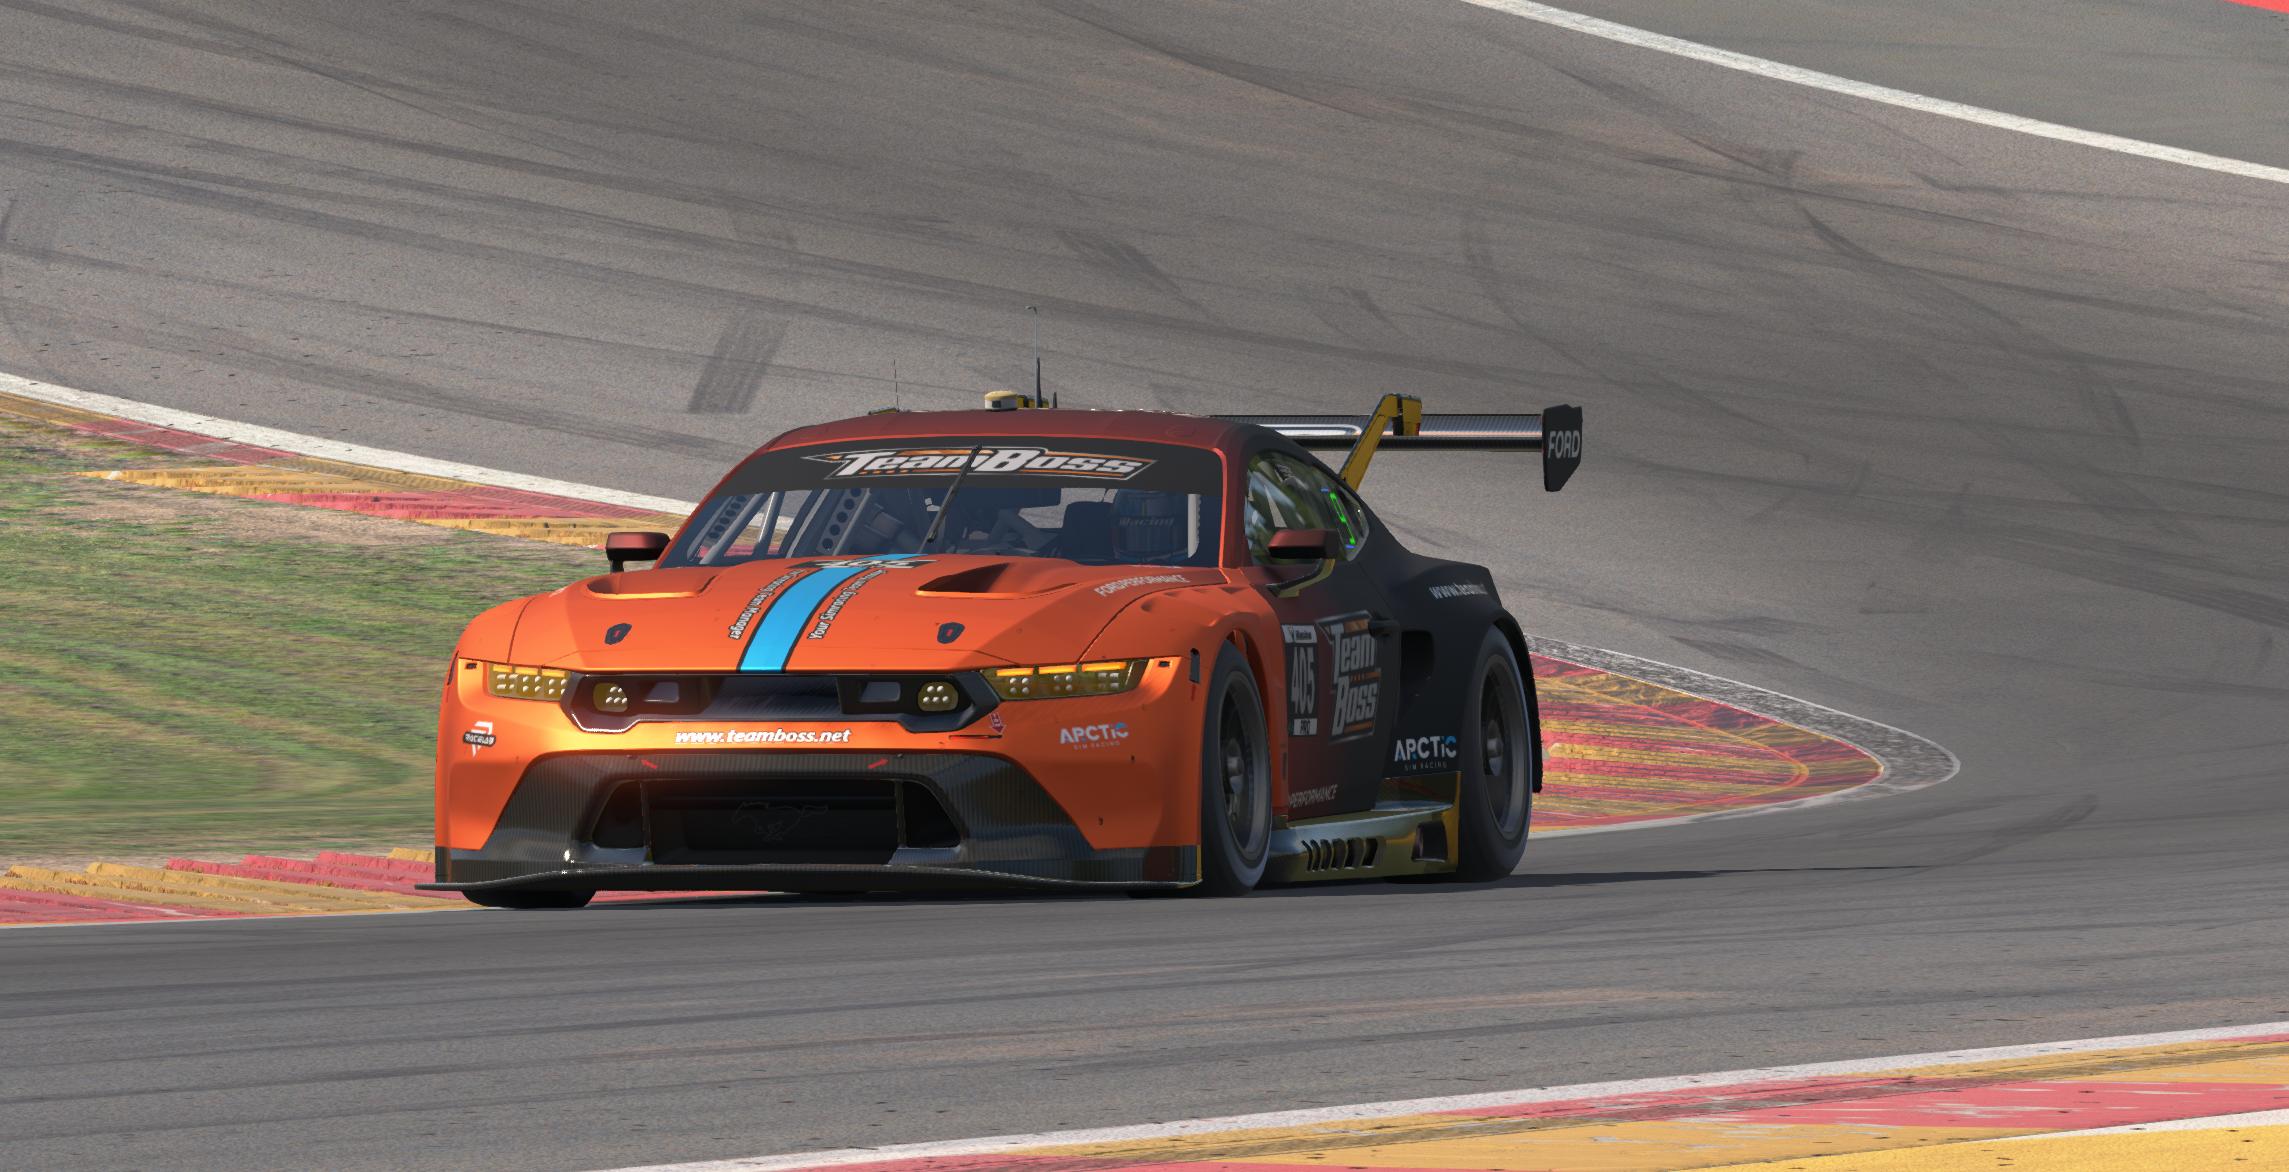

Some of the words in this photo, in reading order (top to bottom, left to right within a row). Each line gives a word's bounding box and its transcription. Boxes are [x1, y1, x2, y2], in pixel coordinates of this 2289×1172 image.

[1548, 430, 1580, 459] FORD
[730, 607, 760, 640] Manager
[808, 621, 830, 639] Your
[1331, 622, 1376, 685] Team
[1291, 646, 1316, 715] 405
[1332, 675, 1379, 737] Boss
[675, 728, 851, 744] www.teamboss.net
[1288, 783, 1338, 808] PERFORMANCE
